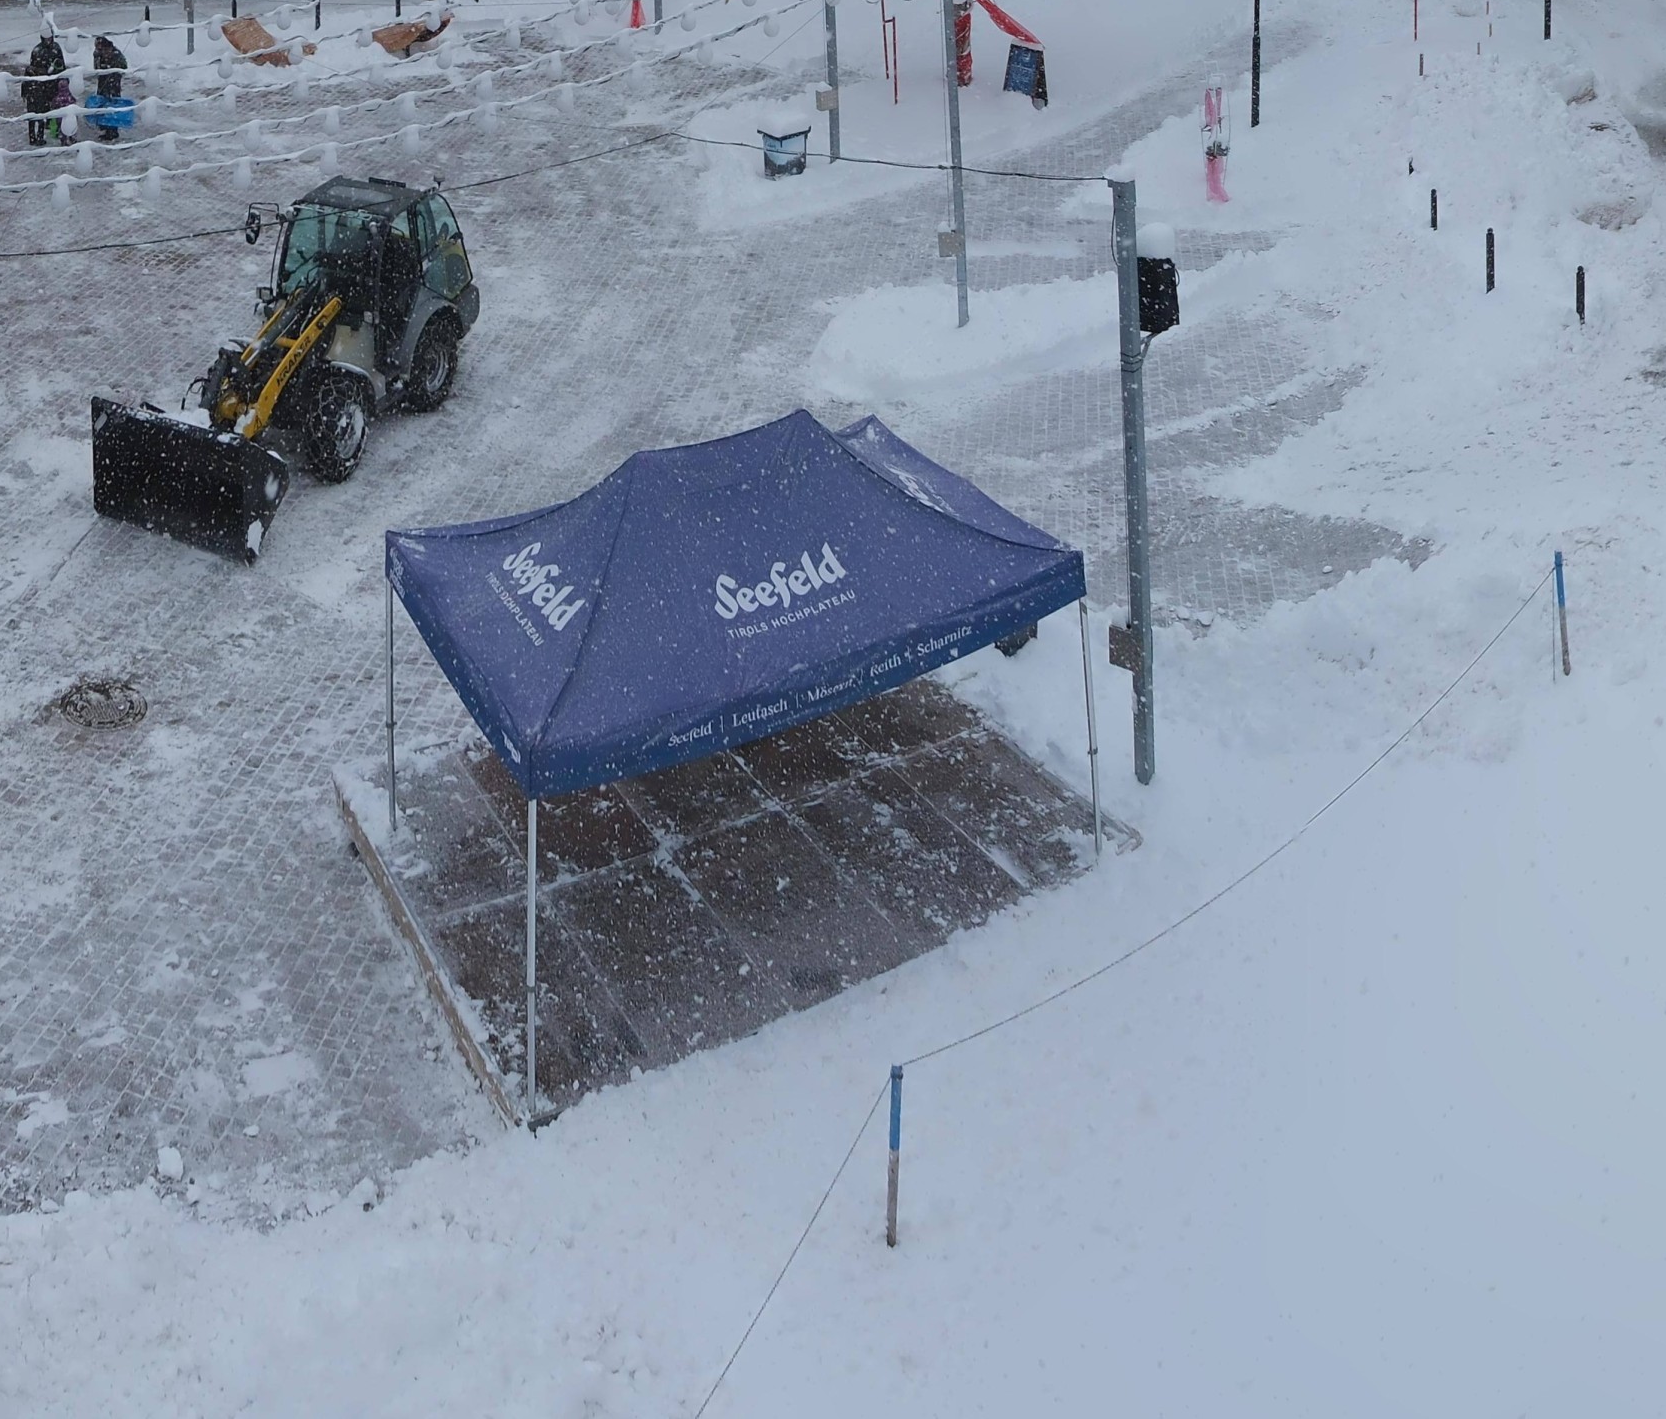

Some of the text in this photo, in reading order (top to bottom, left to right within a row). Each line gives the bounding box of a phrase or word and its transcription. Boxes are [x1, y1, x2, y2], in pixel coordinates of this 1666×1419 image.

[503, 542, 585, 631] Seefeld
[714, 542, 846, 619] Seefeld
[727, 589, 856, 639] TIROLS HOCHPLATEAU
[667, 722, 713, 748] Seefeld
[733, 699, 788, 728] Leutasch
[917, 624, 972, 657] Scharnitz
